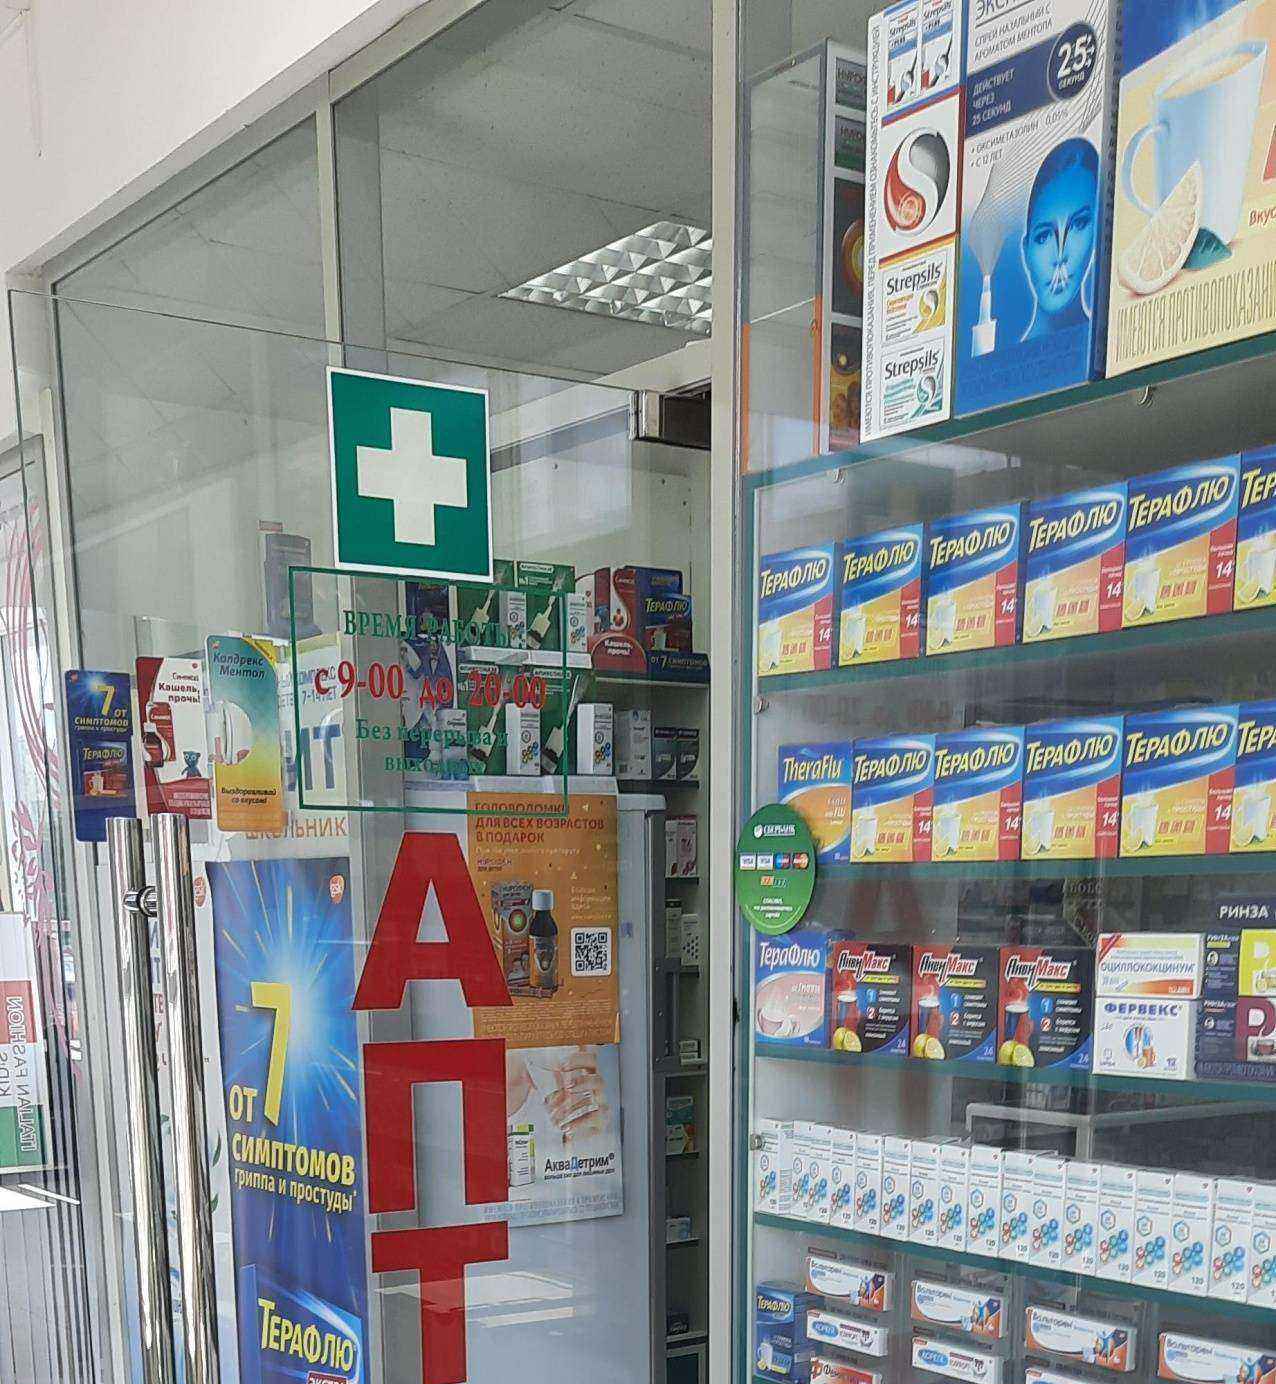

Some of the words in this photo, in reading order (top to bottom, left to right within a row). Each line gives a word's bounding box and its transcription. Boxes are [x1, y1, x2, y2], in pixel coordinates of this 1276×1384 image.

[974, 35, 1016, 62] АРОМАТОМ
[972, 68, 1016, 98] ДЕЙСТВУЕТ
[971, 115, 980, 128] 25
[981, 101, 1013, 124] СЕКУНД
[972, 93, 996, 112] ЧЕРЕЗ
[991, 149, 1003, 162] ЛЕТ
[886, 262, 941, 296] Strepsils
[1116, 297, 1167, 362] ИМЕЮТСЯ
[885, 350, 939, 380] Strepsils
[343, 610, 416, 641] ВРЕМЯ
[219, 666, 265, 679] Ментол
[338, 661, 404, 701] 9-00
[419, 677, 454, 711] до
[468, 669, 547, 709] 20-00
[95, 685, 117, 716] 7
[355, 719, 391, 742] Без
[475, 817, 500, 831] ДЛЯ
[503, 818, 534, 829] ВСЕХ
[537, 818, 605, 830] ВОЗРАСТОВ
[476, 831, 485, 842] В
[486, 832, 545, 845] ПОДАРОК
[1219, 905, 1269, 920] РИНЗА
[1104, 1002, 1178, 1017] ФЕРВЕКС
[250, 982, 292, 1128] 7
[234, 1165, 276, 1193] гриппа
[278, 1178, 287, 1196] и
[1231, 1281, 1245, 1291] 120
